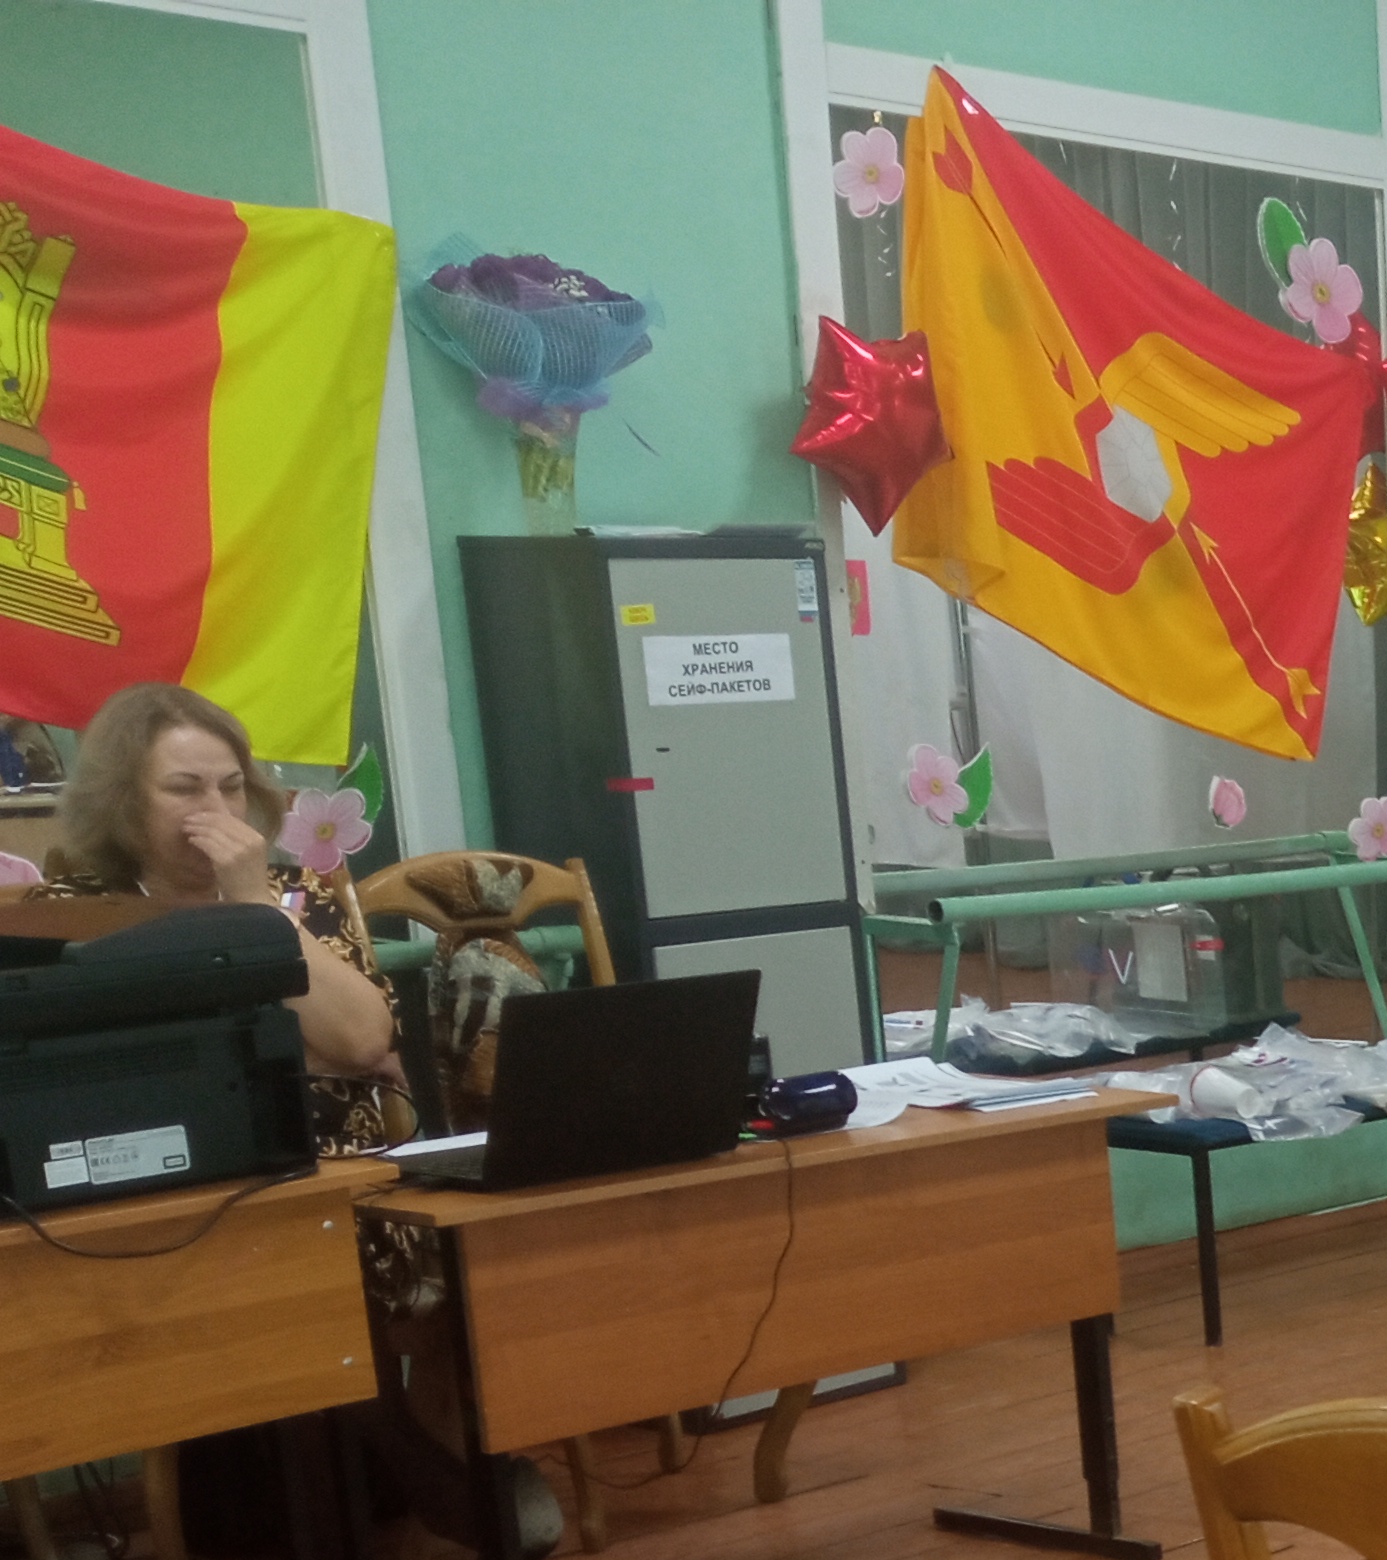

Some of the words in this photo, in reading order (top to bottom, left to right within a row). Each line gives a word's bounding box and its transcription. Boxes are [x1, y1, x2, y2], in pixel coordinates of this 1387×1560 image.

[692, 641, 739, 656] МЕСТО
[682, 660, 754, 677] ХРАНЕНИЯ
[668, 678, 771, 697] СЕЙФ-ПАКЕТОВ
